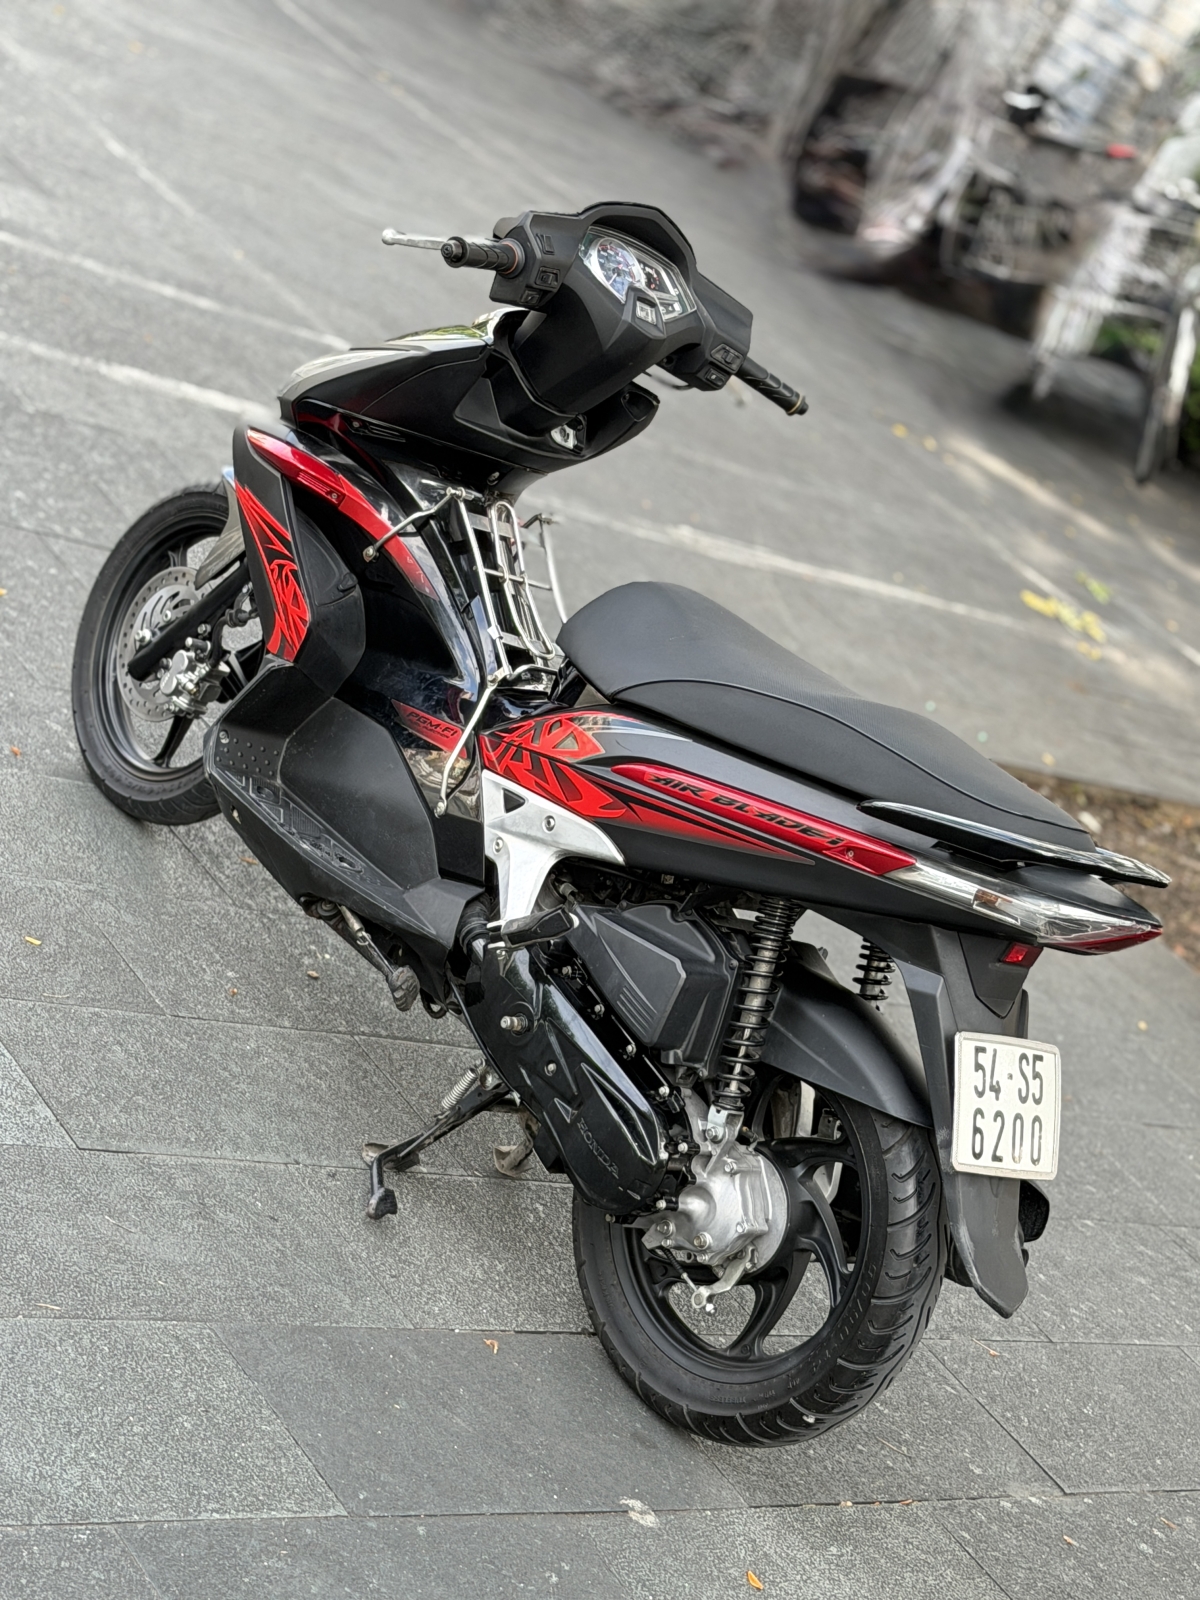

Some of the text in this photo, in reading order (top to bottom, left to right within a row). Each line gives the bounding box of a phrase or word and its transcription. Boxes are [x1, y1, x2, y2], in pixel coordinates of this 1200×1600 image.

[651, 772, 706, 799] AIR
[577, 1117, 620, 1179] HONDA
[971, 1107, 1043, 1166] 6200
